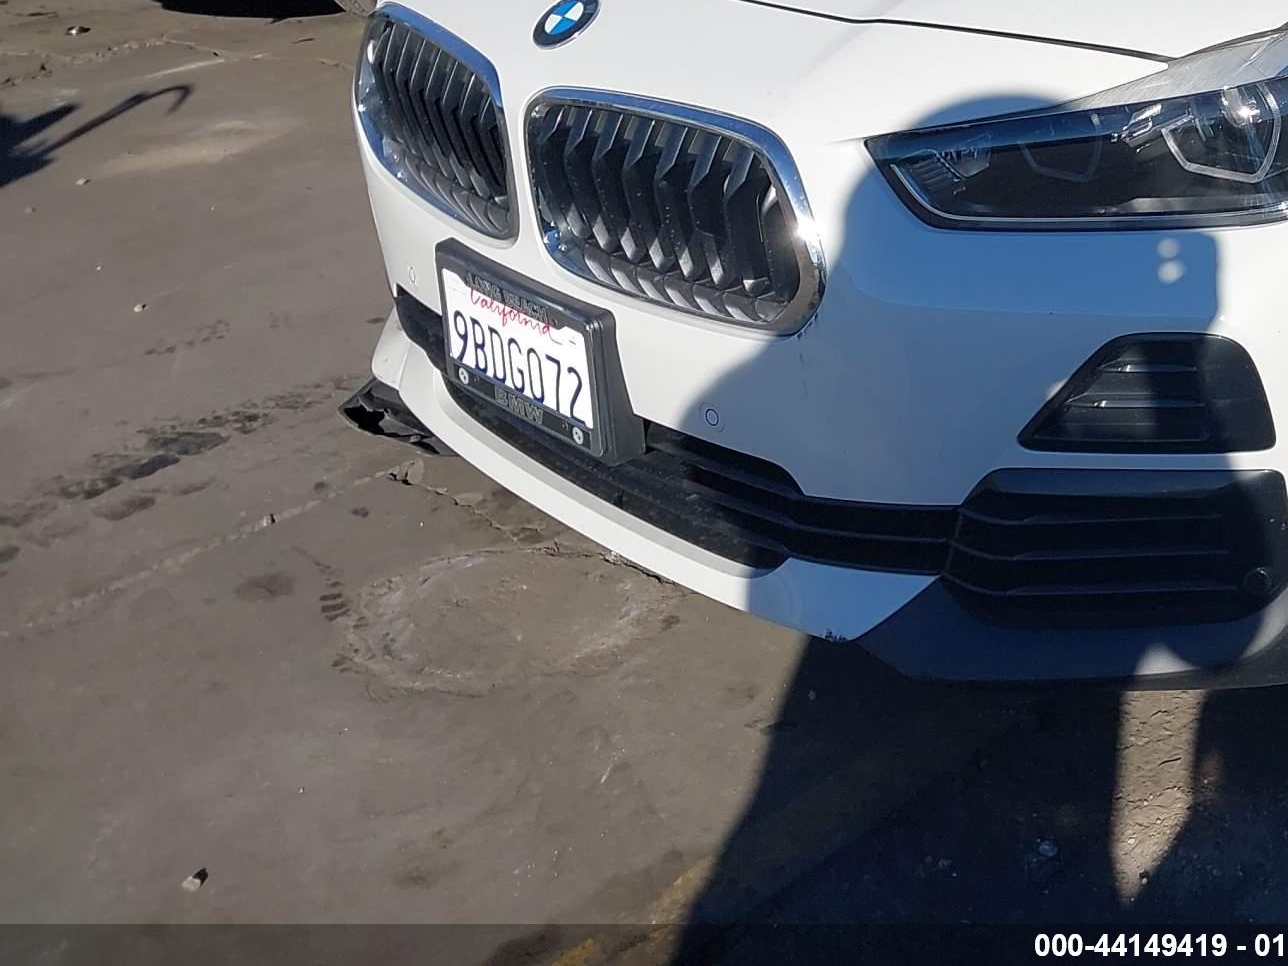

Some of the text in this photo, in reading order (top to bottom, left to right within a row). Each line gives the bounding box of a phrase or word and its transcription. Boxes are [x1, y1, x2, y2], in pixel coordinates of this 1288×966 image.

[470, 288, 562, 345] California
[453, 310, 587, 425] 9BDG072
[494, 386, 544, 424] BMW
